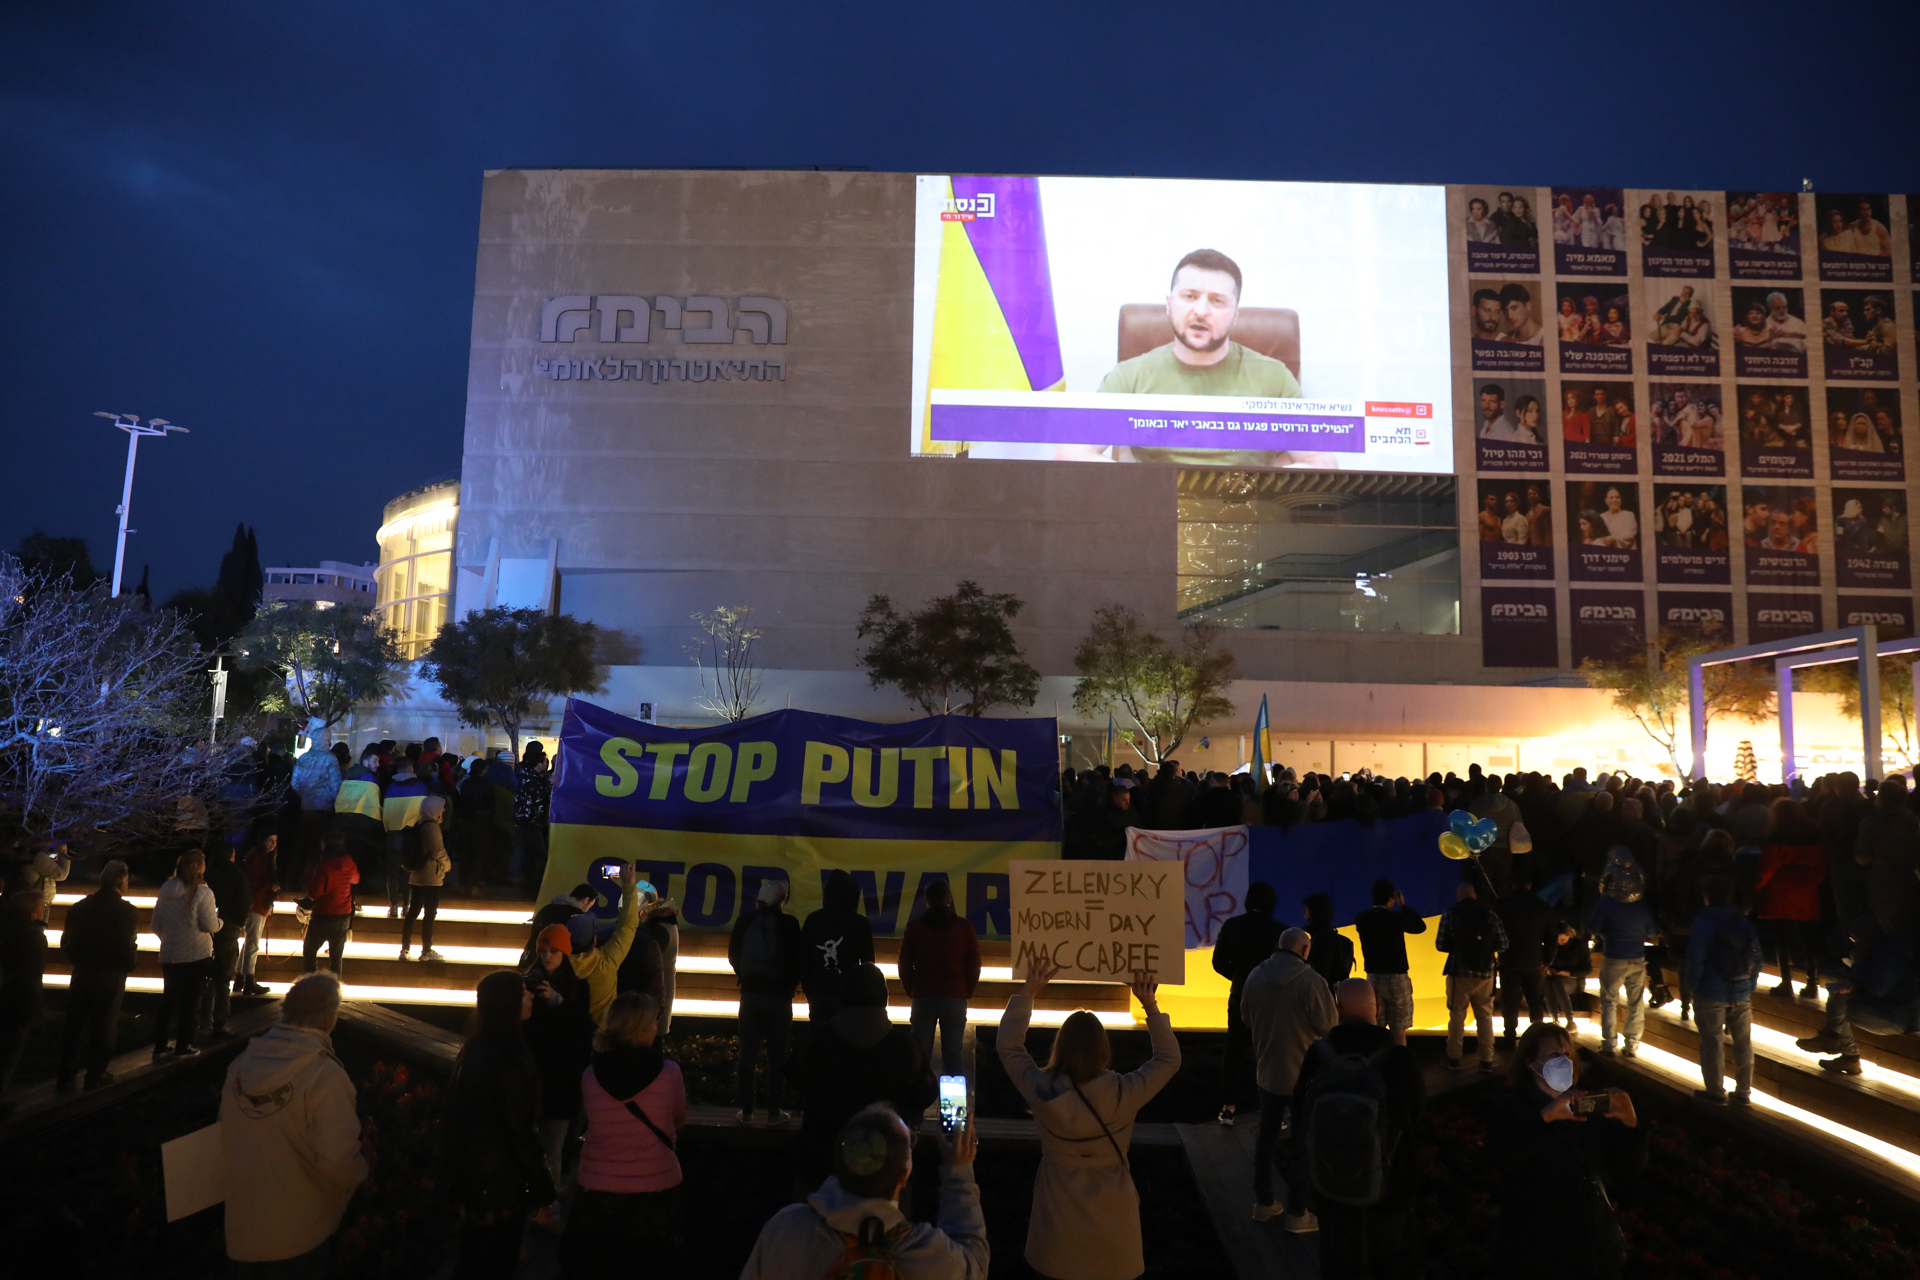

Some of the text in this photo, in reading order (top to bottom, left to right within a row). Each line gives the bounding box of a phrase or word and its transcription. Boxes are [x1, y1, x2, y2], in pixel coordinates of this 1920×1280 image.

[1566, 254, 1616, 262] מאמא מיה
[540, 295, 787, 345] הבימה
[1497, 350, 1527, 358] שאהבה
[1564, 350, 1627, 362] זאקופנה שלי
[1687, 353, 1699, 363] לא
[1701, 355, 1716, 363] אני
[1772, 357, 1799, 365] זורבה
[540, 356, 786, 384] התיאטרון הלאומי
[1242, 401, 1352, 412] נשיא אוקראינה זלנסקי:
[1128, 418, 1354, 434] "הטילים הרוסים פגעו גם בבאבי יאר ובאומן"
[1396, 427, 1411, 435] תא
[1370, 435, 1411, 444] הכתבים
[1482, 448, 1542, 459] וכי מהו טיול
[1662, 453, 1716, 463] המלט 2021
[1497, 552, 1537, 560] יפו 1903
[1581, 554, 1630, 564] סימני דרך
[1661, 554, 1726, 565] זרים מושלמים
[1847, 558, 1899, 569] מצדה 1942
[1491, 604, 1548, 616] הבימה
[1580, 606, 1636, 618] הבימה
[1757, 609, 1814, 622] הבימה
[1848, 612, 1905, 625] הבימה
[594, 736, 1020, 810] STOP PUTIN
[1024, 870, 1168, 900] ZELENSKY
[587, 856, 790, 927] STOP
[1018, 908, 1156, 936] MODERN DAY
